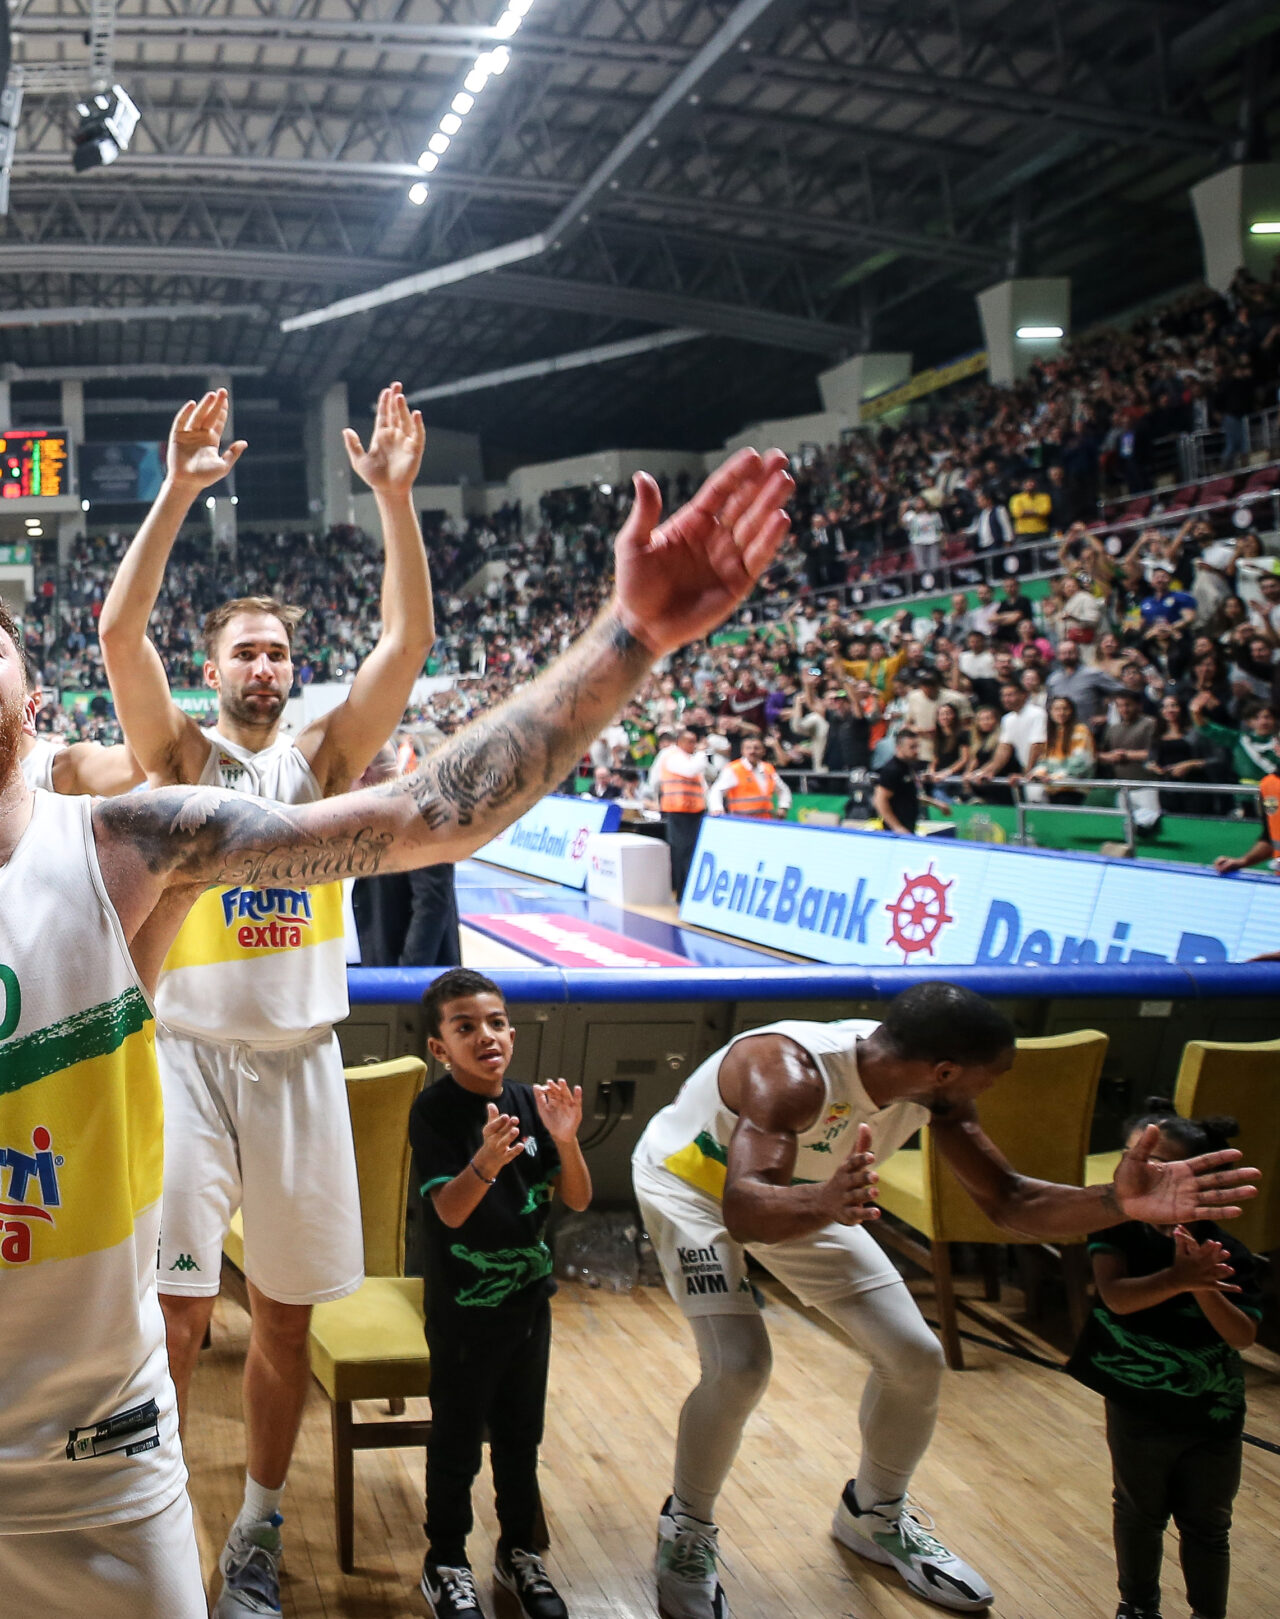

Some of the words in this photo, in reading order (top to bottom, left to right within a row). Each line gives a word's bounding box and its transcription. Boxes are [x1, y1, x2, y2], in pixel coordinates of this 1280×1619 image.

[510, 820, 568, 859] DenizBank
[692, 851, 879, 945] DenizBank
[237, 921, 302, 948] extra
[676, 1244, 719, 1265] Kent
[686, 1274, 729, 1296] AVM
